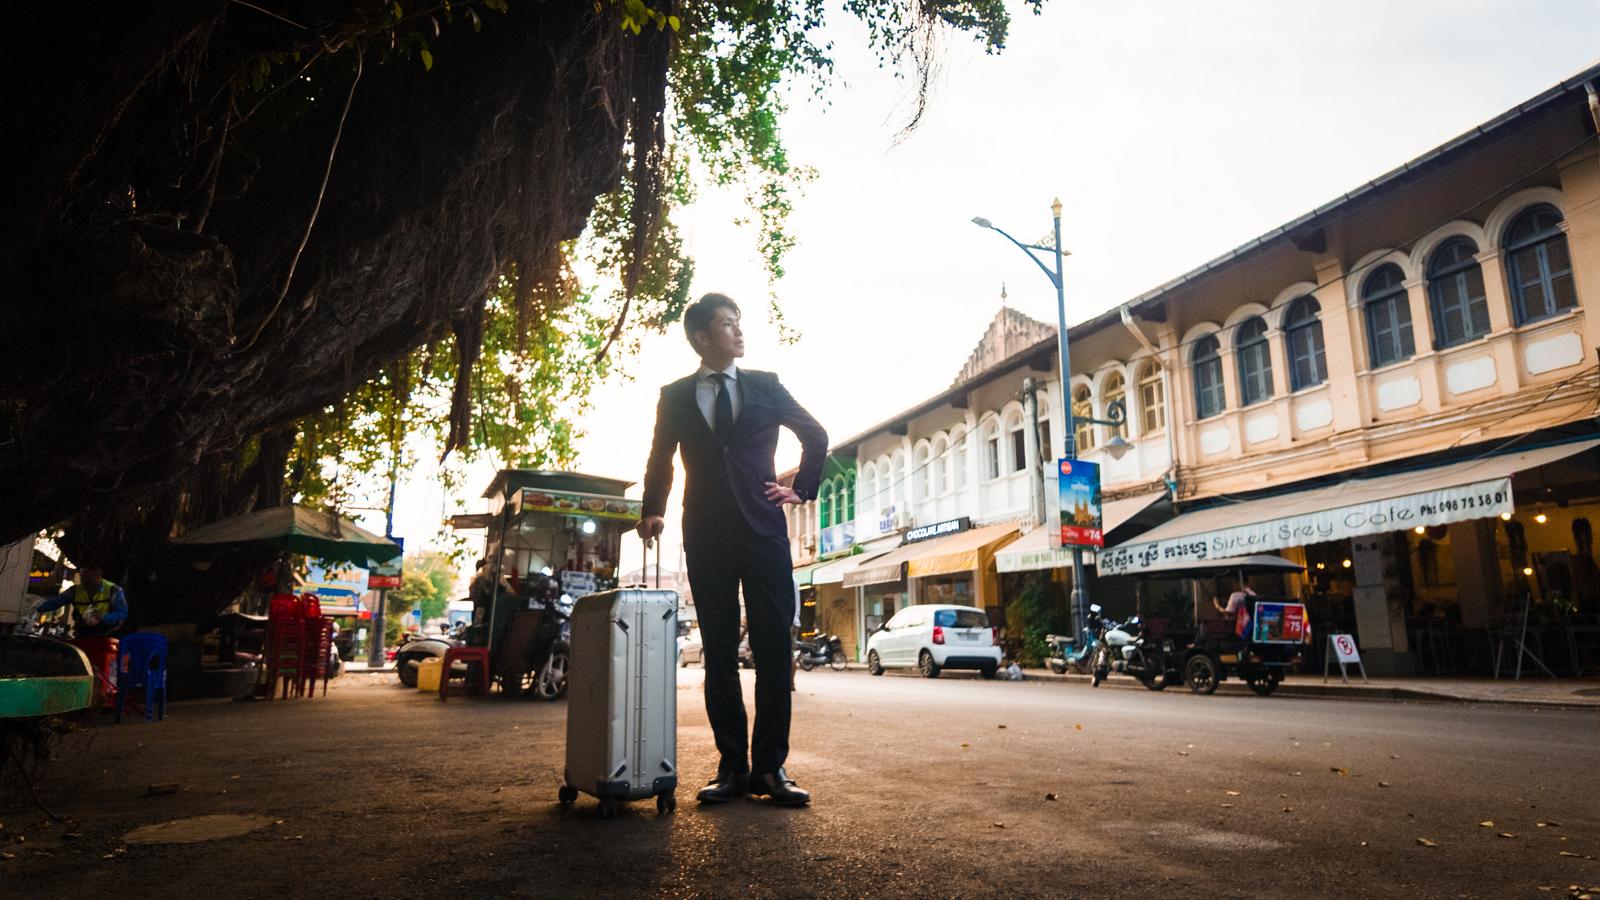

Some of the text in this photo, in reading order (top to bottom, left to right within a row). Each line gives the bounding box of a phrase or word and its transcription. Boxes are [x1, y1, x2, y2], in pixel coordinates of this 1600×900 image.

[1420, 491, 1508, 517] Ph: 098 72 38 01
[1212, 506, 1415, 552] Sister Srey Cafe
[1290, 621, 1301, 632] 75
